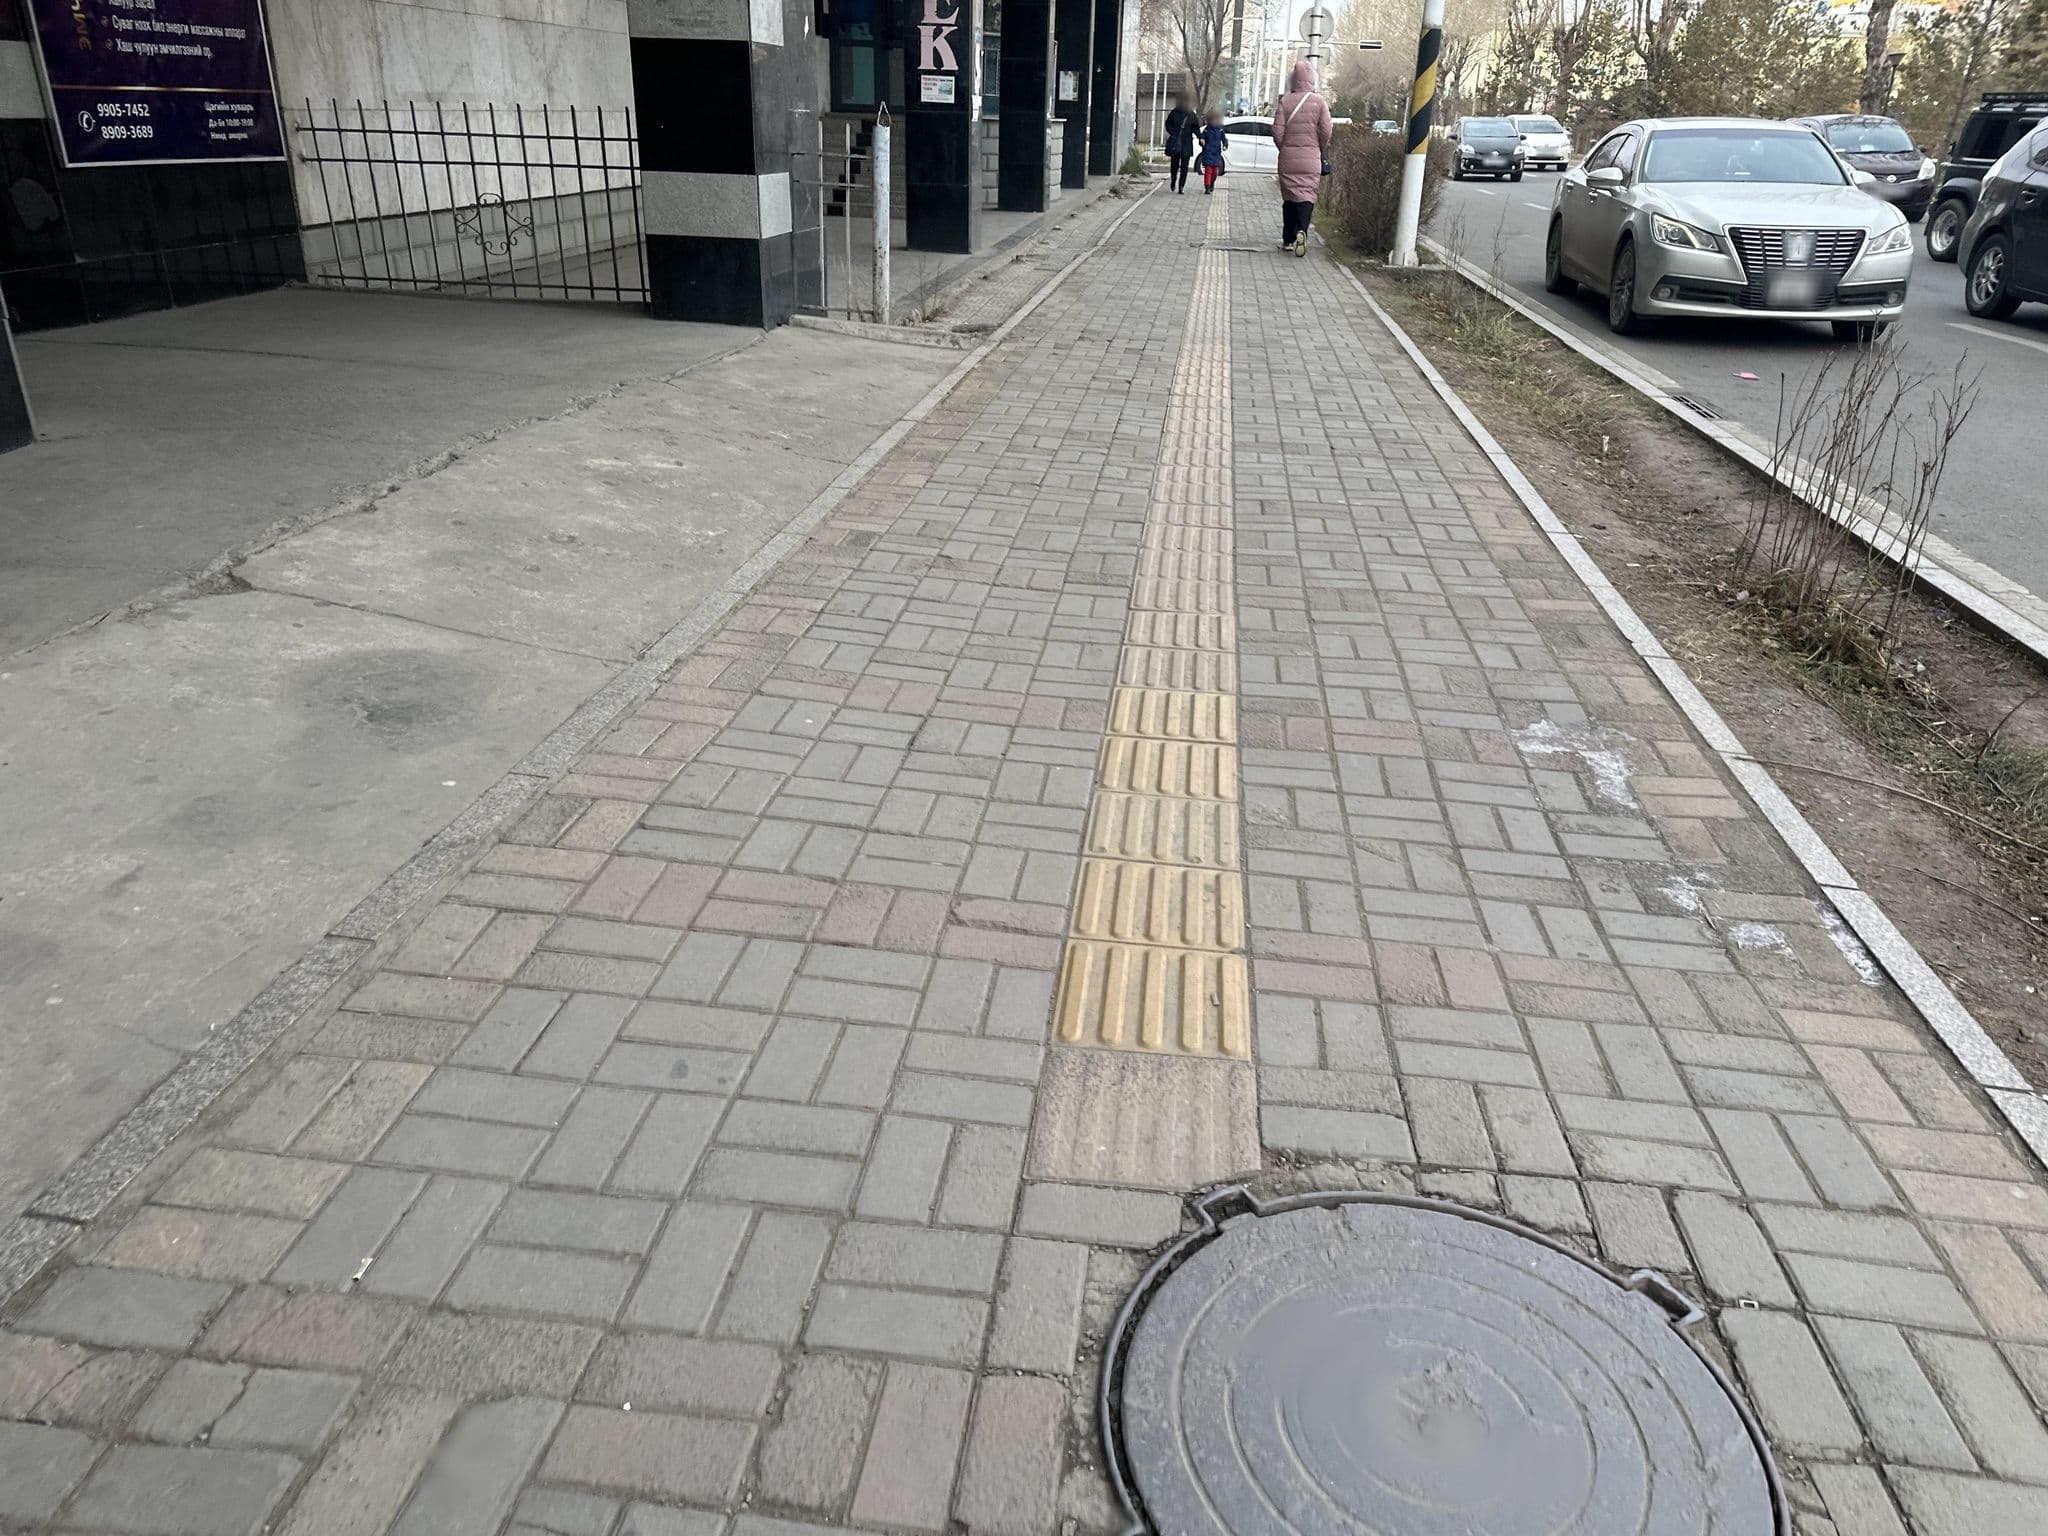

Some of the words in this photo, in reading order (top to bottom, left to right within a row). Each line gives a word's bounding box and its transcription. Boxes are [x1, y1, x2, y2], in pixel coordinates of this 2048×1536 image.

[115, 38, 133, 52] Хаш
[97, 103, 150, 117] 9905-7452
[101, 125, 153, 139] 8909-3689
